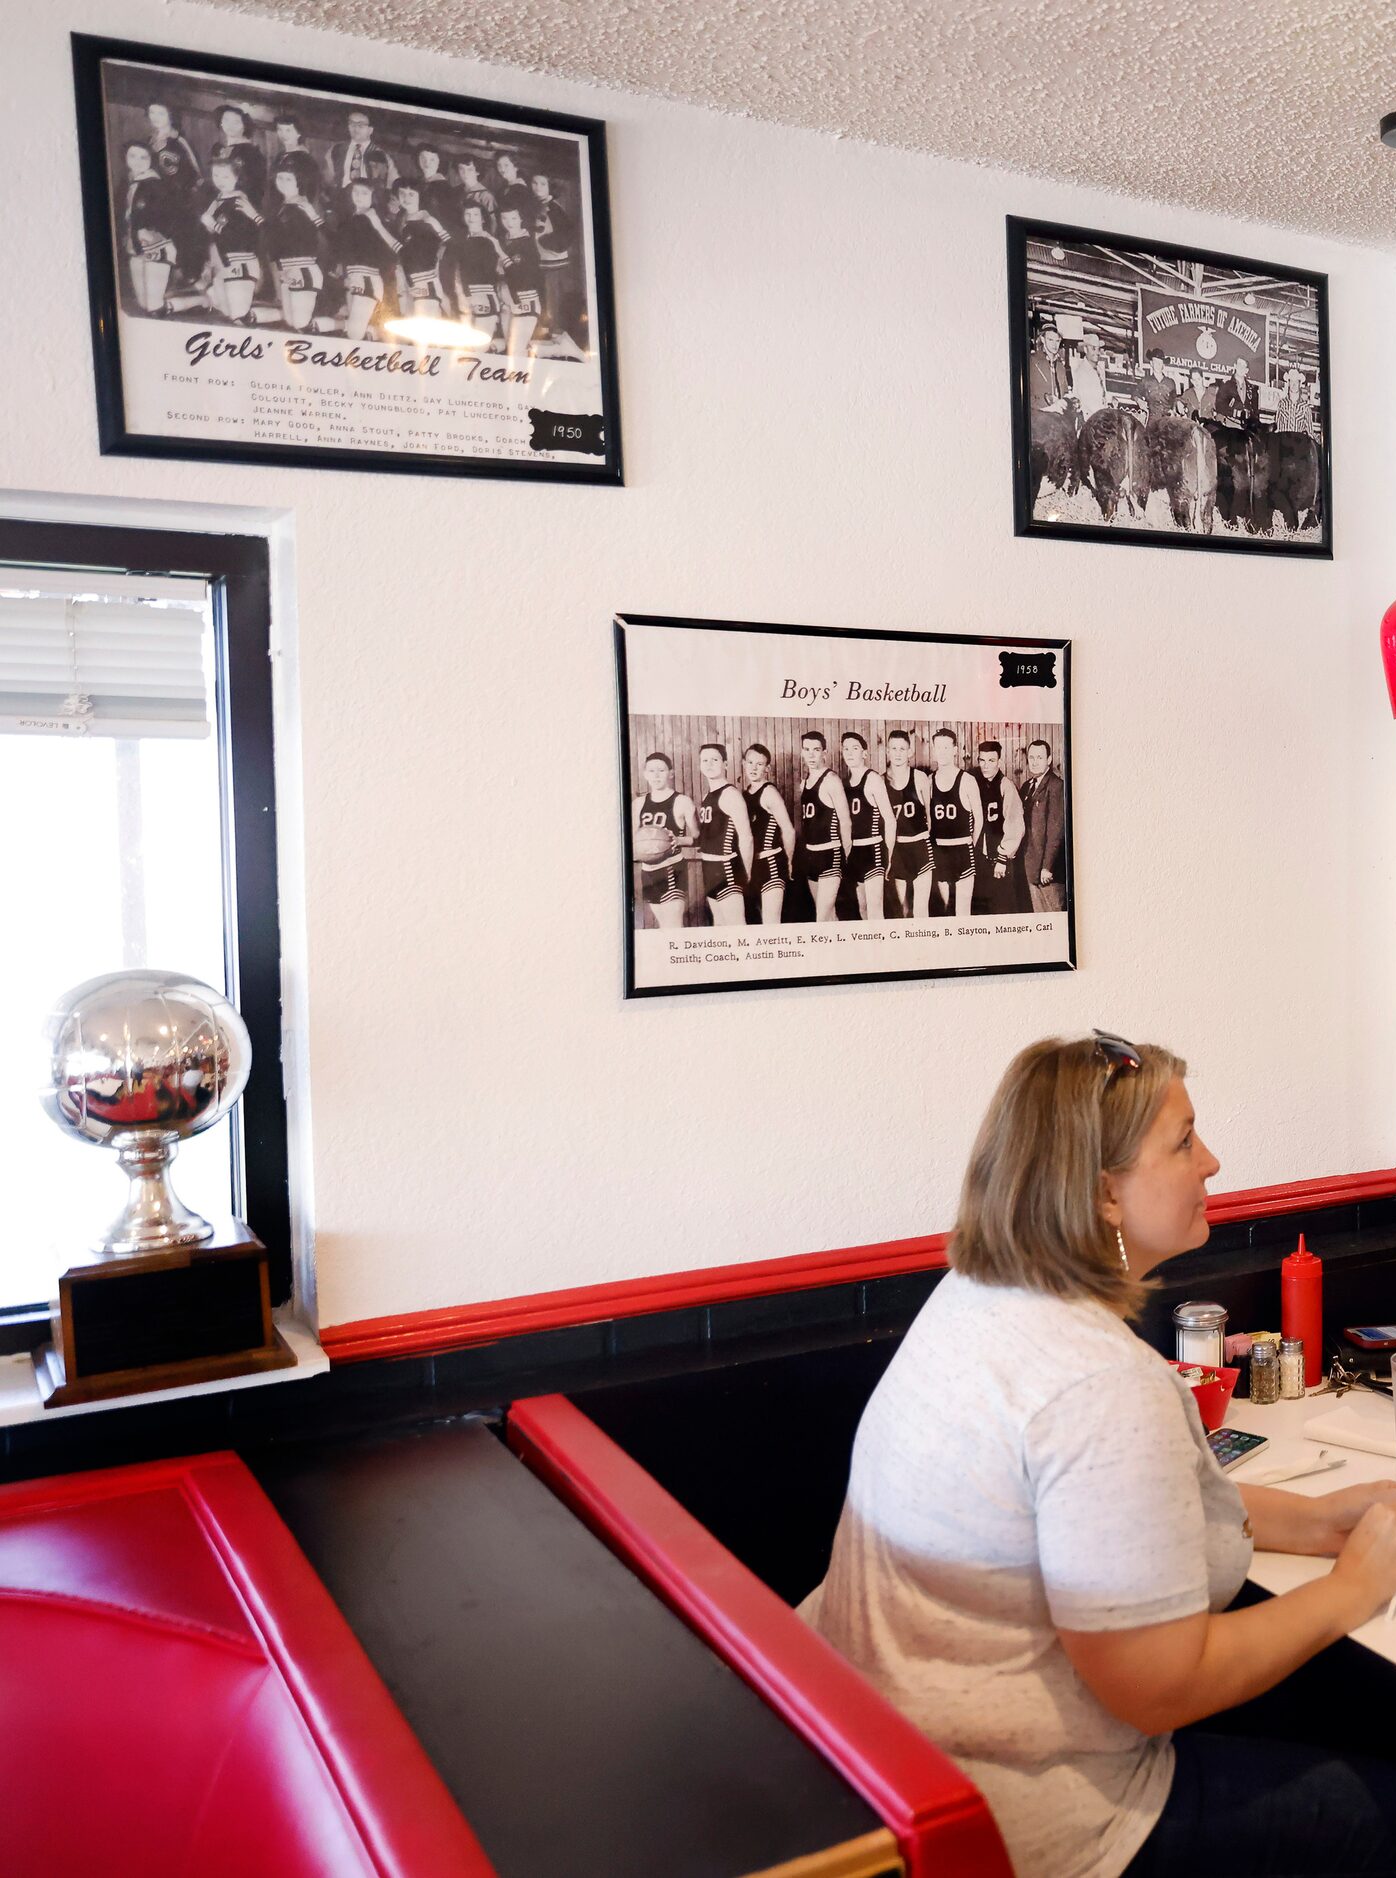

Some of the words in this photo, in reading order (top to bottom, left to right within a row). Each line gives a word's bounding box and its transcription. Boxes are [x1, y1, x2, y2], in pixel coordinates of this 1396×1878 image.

[517, 303, 530, 312] 40
[1146, 305, 1179, 334] FUTURE
[1178, 303, 1215, 324] FARMERS
[1216, 309, 1228, 329] OF
[1227, 316, 1262, 353] AMERICA
[185, 330, 273, 368] Girls'
[284, 339, 441, 378] Basketball
[457, 357, 532, 386] Team
[164, 373, 200, 384] FRONT
[207, 378, 236, 388] ROW:
[250, 380, 292, 391] GLORIA
[353, 390, 373, 399] ANN
[251, 393, 313, 407] COLQUITT,
[320, 398, 354, 409] BECKY
[360, 401, 431, 416] YOUNGBLOOD,
[438, 408, 457, 417] PAT
[253, 406, 294, 417] JEANNE
[301, 409, 348, 421] WARREN.
[167, 411, 210, 422] SECOND
[217, 415, 246, 425] ROW:
[253, 418, 281, 427] MARY
[288, 421, 322, 432] GOOD,
[329, 424, 356, 433] ANNA
[362, 426, 401, 438] STOUT,
[408, 430, 440, 439] PATTY
[446, 432, 489, 444] BROOKS,
[495, 436, 527, 445] COACH
[552, 424, 583, 440] 1950
[254, 431, 309, 443] HARRELL,
[317, 434, 343, 443] ANNA
[403, 441, 428, 450] JOAN
[433, 443, 465, 454] FORD,
[472, 446, 503, 455] DORIS
[508, 448, 556, 460] STEVENS,
[1016, 664, 1039, 675] 1958
[780, 679, 838, 706] Boys'
[846, 681, 947, 704] Basketball
[934, 803, 957, 820] 60
[986, 802, 999, 822] C
[669, 941, 679, 950] R.
[684, 939, 732, 950] Davidson,
[737, 938, 750, 947] M.
[755, 936, 792, 946] Averitt,
[796, 935, 806, 944] E.
[811, 934, 833, 944] Key,
[836, 934, 846, 942] L.
[851, 932, 885, 941] Venner,
[889, 931, 900, 939] C.
[905, 929, 940, 938] Rushing,
[944, 928, 953, 936] B.
[957, 926, 991, 936] Slayton,
[995, 925, 1032, 934] Manager,
[1035, 923, 1053, 931] Carl
[670, 953, 702, 964] Smith;
[705, 952, 740, 962] Coach,
[745, 950, 774, 960] Austin
[777, 949, 805, 959] Burns.
